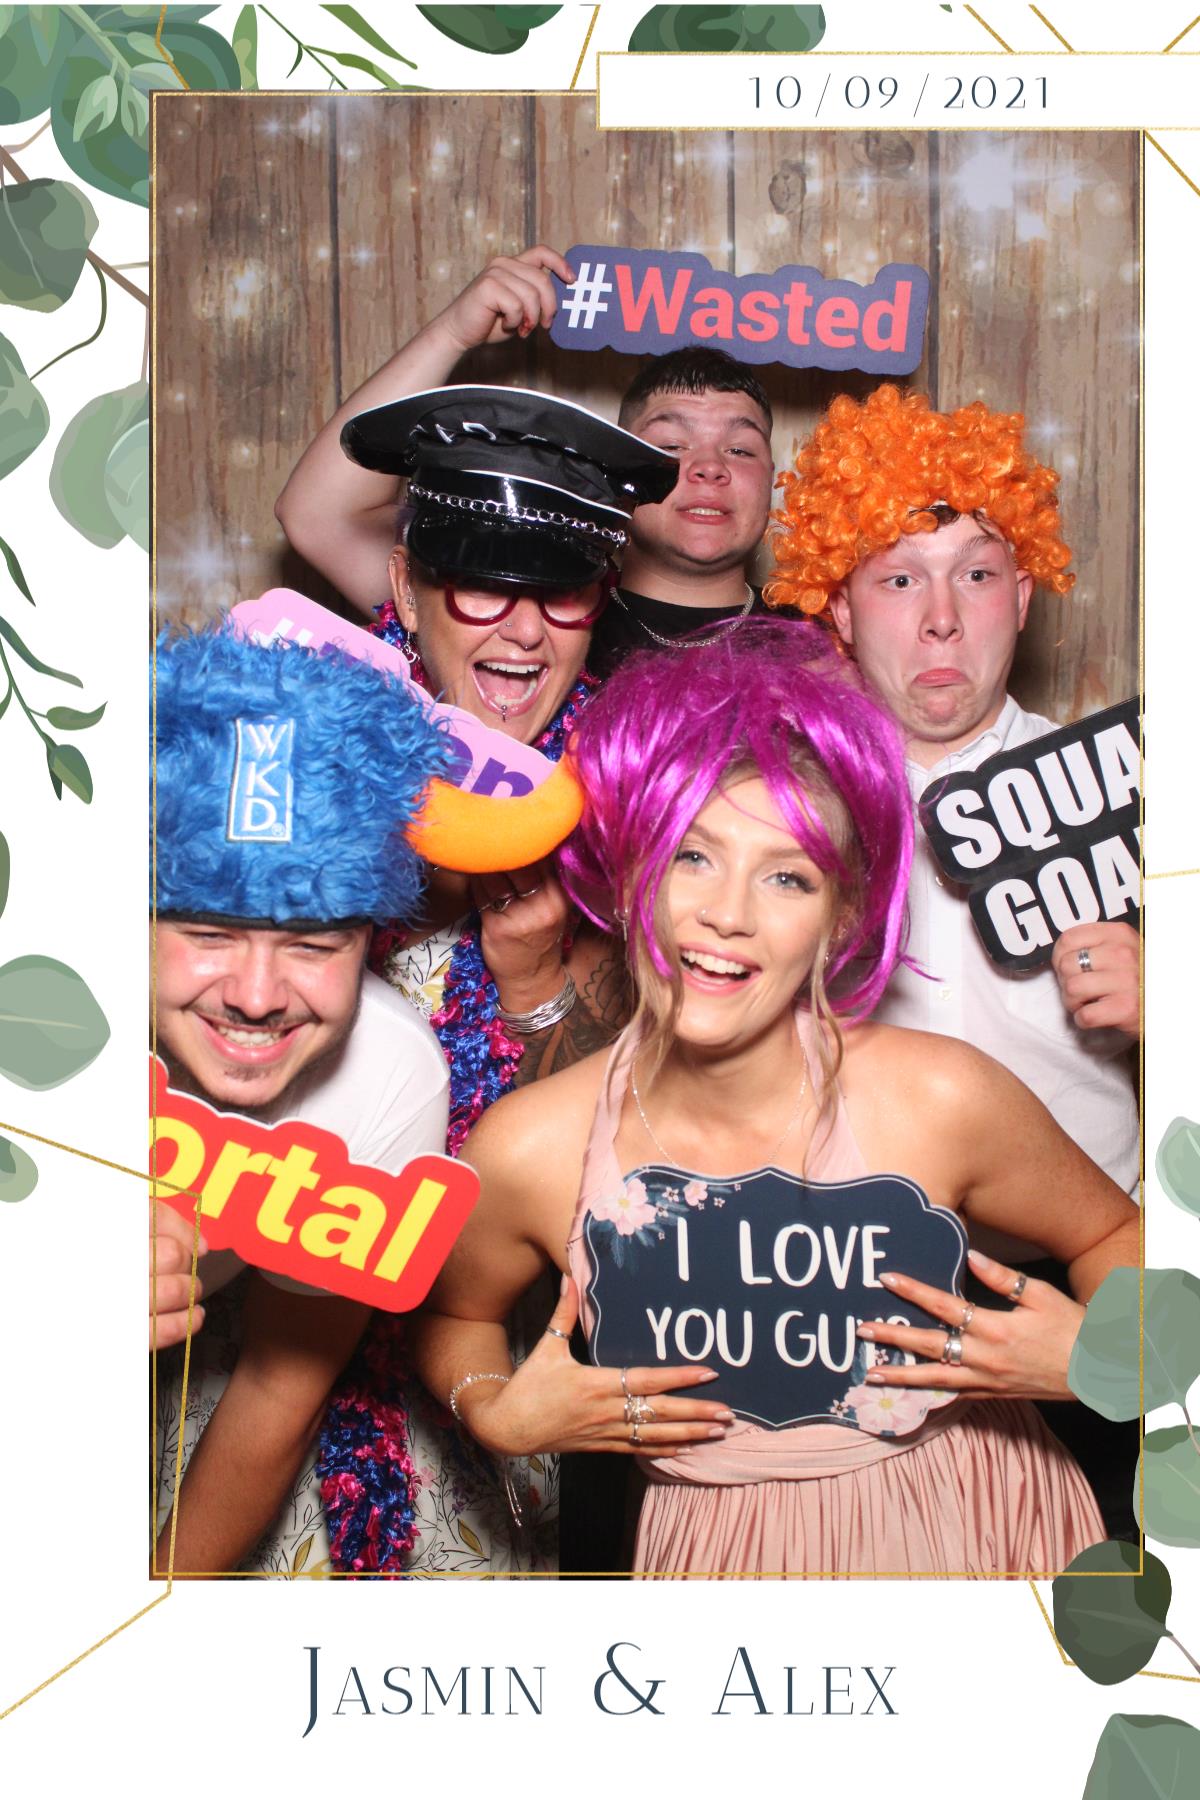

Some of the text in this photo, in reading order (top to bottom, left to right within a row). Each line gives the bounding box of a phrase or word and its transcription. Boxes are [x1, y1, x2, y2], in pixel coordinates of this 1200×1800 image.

[561, 262, 912, 353] #Wasted
[936, 714, 1145, 870] SQUA
[985, 824, 1145, 956] GOA
[677, 1217, 891, 1290] I LOVE
[645, 1307, 752, 1368] YOU
